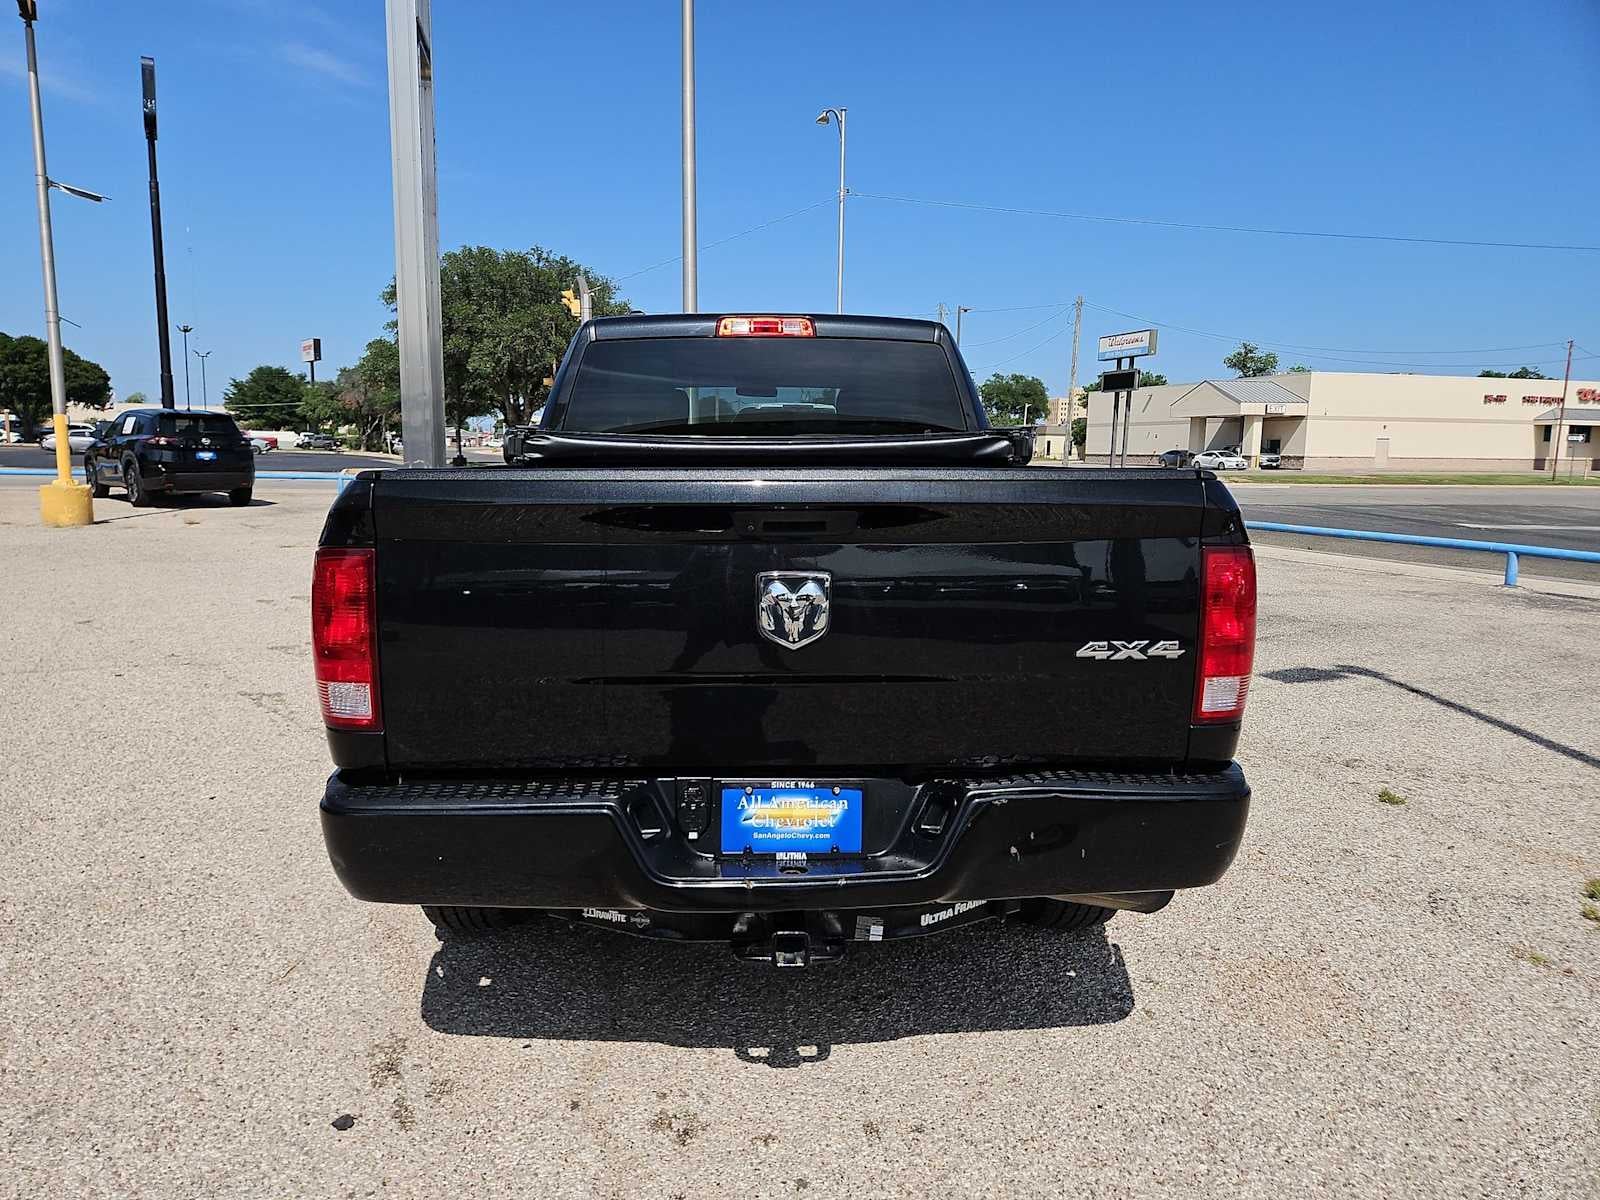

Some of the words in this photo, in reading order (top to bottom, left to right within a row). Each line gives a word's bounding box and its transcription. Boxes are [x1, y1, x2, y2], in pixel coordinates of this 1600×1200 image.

[771, 781, 796, 789] SINCE
[737, 795, 762, 810] All
[769, 796, 849, 810] American
[752, 813, 836, 828] Chevrolet
[753, 832, 831, 840] SanAngeloChevy.com
